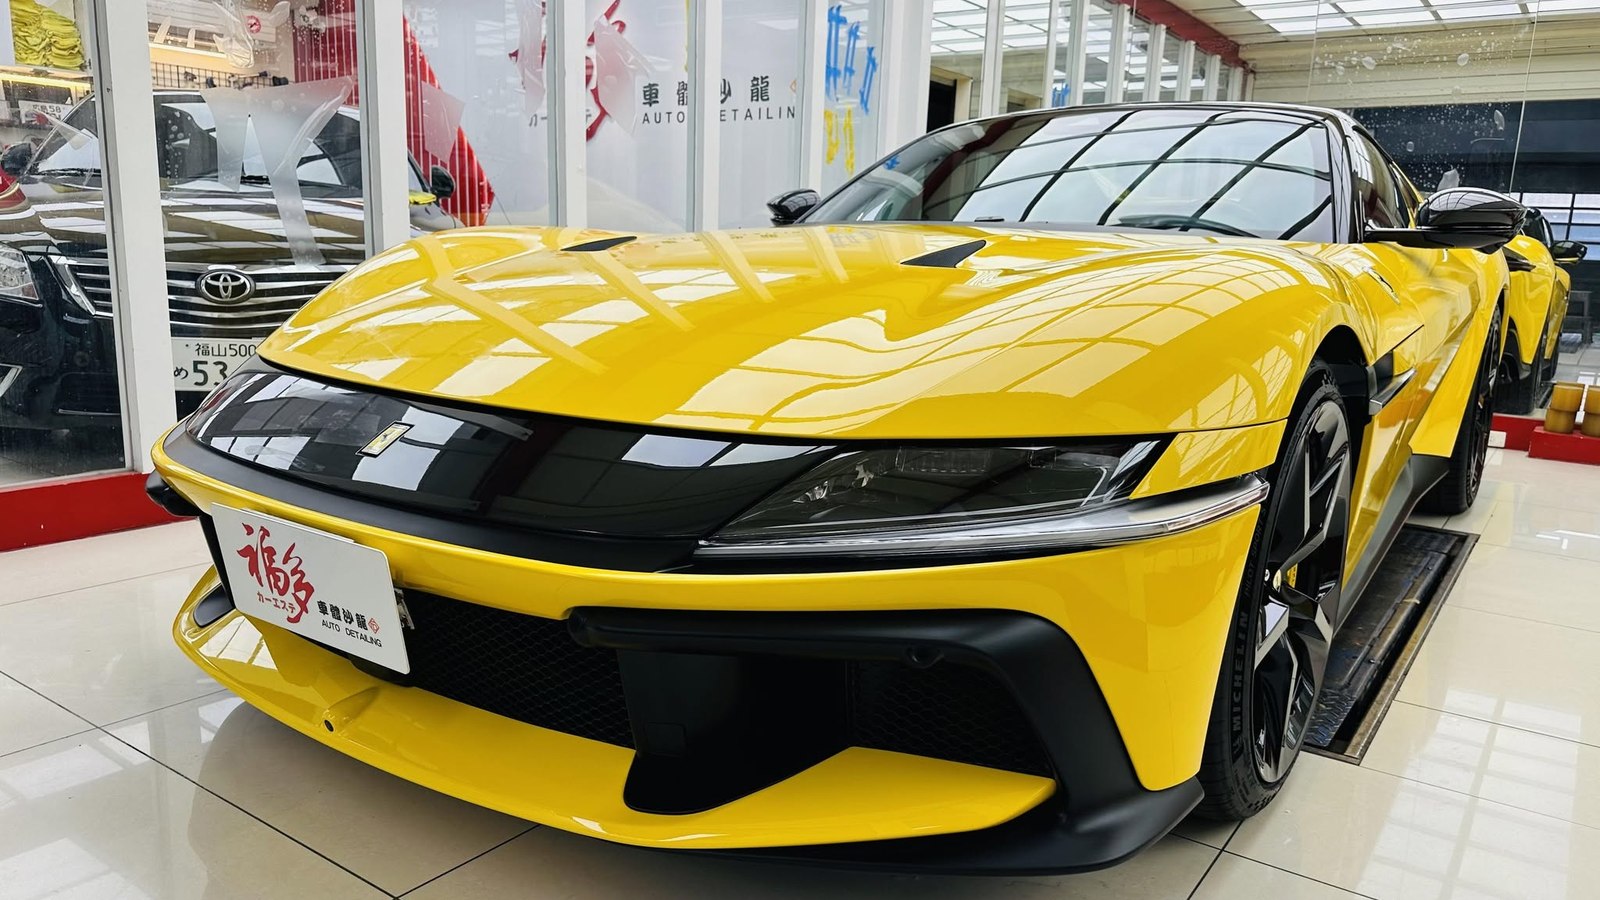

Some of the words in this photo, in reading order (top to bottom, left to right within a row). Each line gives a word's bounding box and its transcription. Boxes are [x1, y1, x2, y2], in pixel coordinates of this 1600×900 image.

[642, 111, 686, 125] AUTO
[719, 106, 796, 122] ETAILIN
[195, 343, 256, 357] 福山500
[257, 591, 296, 614] カーエステ
[321, 619, 341, 632] AUTO
[345, 627, 383, 648] DETAILING
[1232, 611, 1248, 731] MICHELIN
